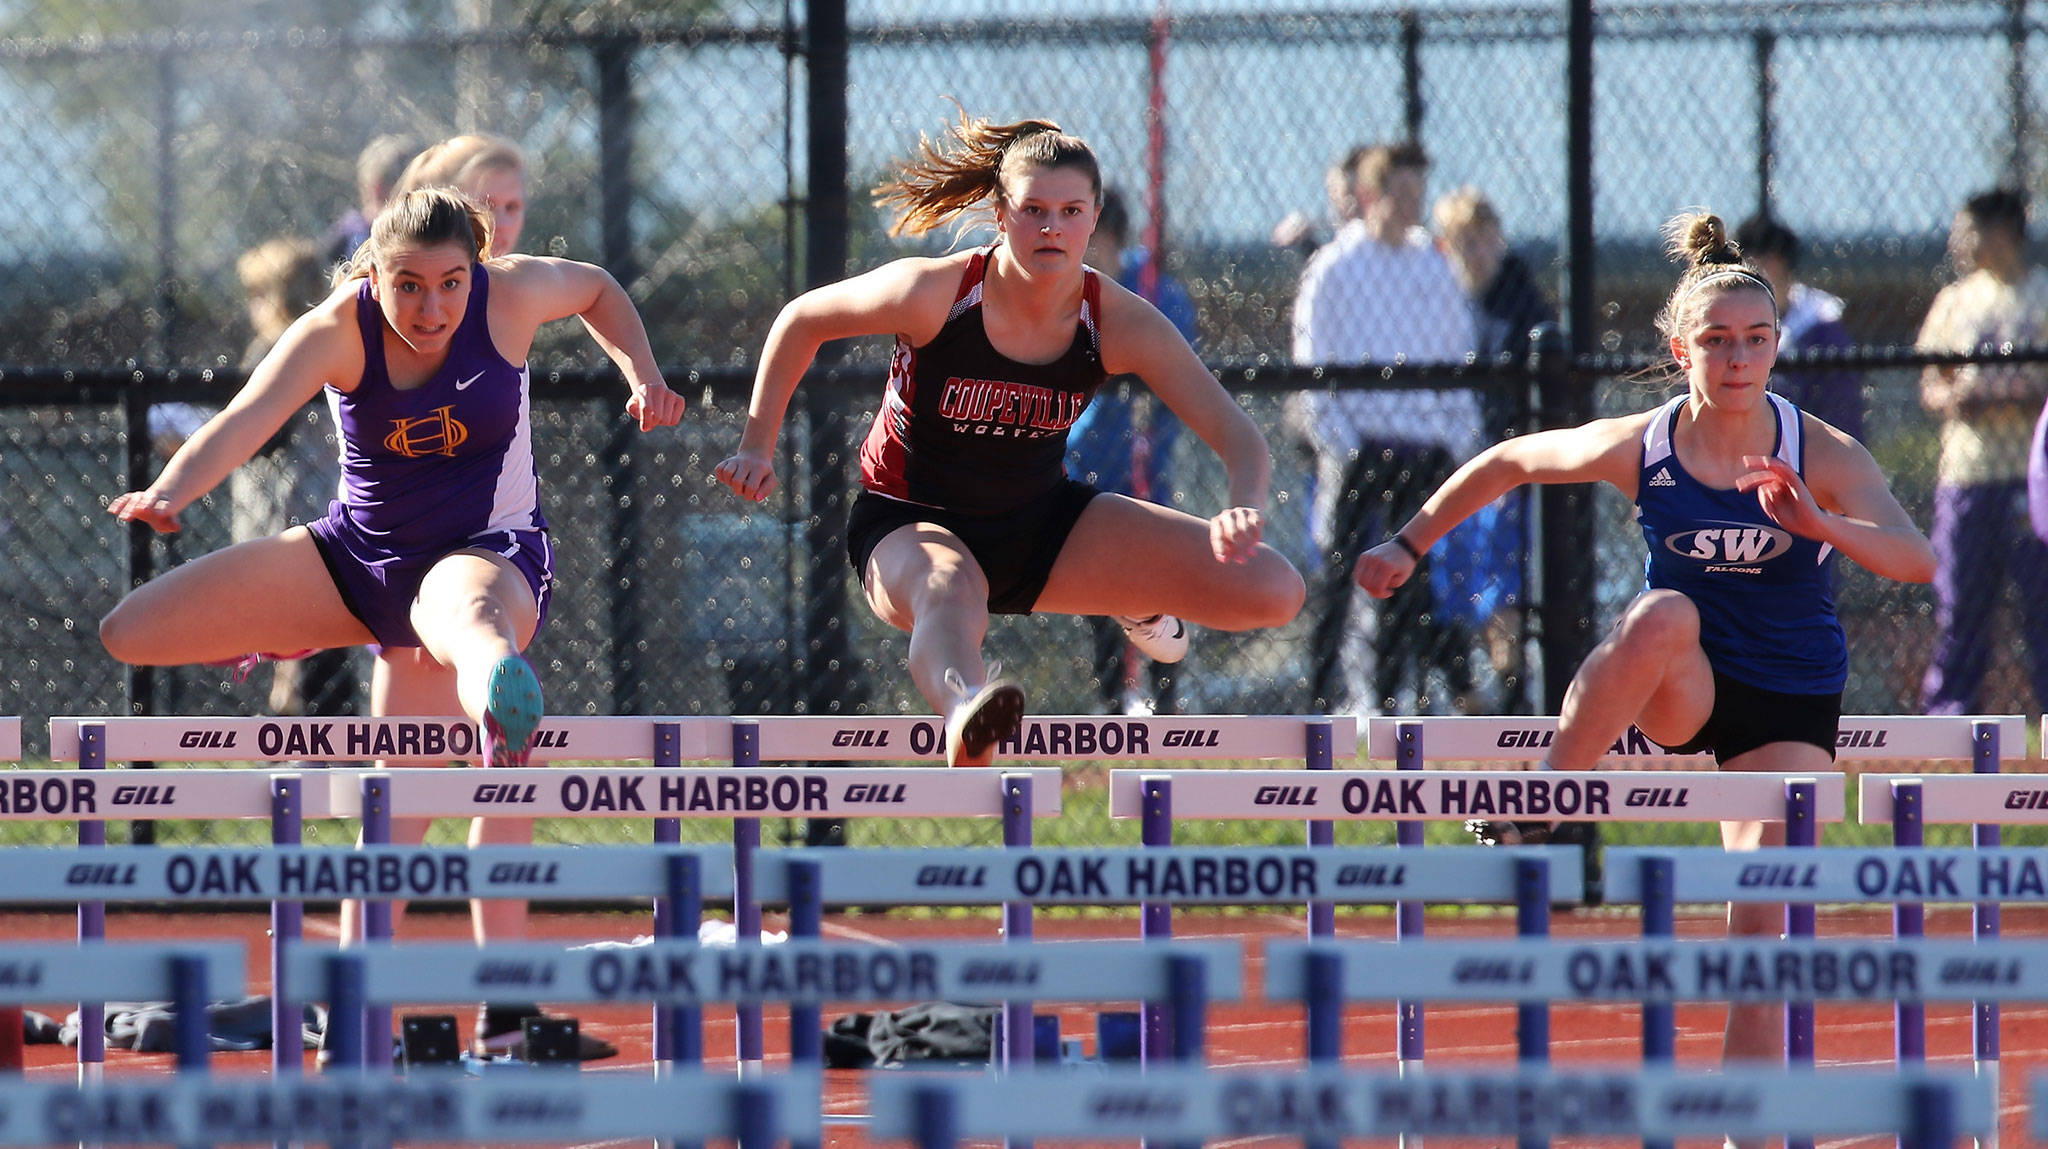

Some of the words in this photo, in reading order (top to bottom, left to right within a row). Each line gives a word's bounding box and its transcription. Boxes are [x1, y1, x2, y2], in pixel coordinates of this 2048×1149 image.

[952, 422, 1060, 439] WOLVE
[1648, 478, 1676, 487] adidas
[1689, 527, 1772, 562] SW
[1704, 565, 1763, 575] FALCONS
[179, 730, 237, 748] GILL
[258, 723, 335, 755] OAK
[533, 730, 569, 748] ILL
[832, 729, 889, 747] GILL
[1162, 729, 1220, 747] GILL
[1497, 730, 1553, 748] GILL
[1836, 730, 1888, 748] GILL
[111, 785, 176, 806] GILL
[473, 783, 538, 803] GILL
[560, 775, 646, 812] OAK
[659, 775, 828, 812] HARBOR
[843, 783, 908, 803] GILL
[1253, 786, 1318, 806] GILL
[1341, 778, 1427, 815] OAK
[1441, 778, 1610, 815] HARBOR
[1626, 788, 1690, 808] GILL
[66, 862, 138, 886] GILL
[166, 855, 262, 895] OAK
[279, 854, 470, 895] HARBOR
[488, 861, 560, 885] GILL
[916, 864, 989, 888] GILL
[1014, 856, 1109, 897] OAK
[1127, 856, 1318, 897] HARBOR
[1335, 863, 1408, 887] GILL
[1737, 863, 1820, 889] GILL
[1856, 856, 1960, 897] OAK
[588, 951, 698, 998] OAK
[715, 951, 940, 998] HARBOR
[1565, 949, 1676, 996] OAK
[1697, 949, 1921, 996] HARBOR
